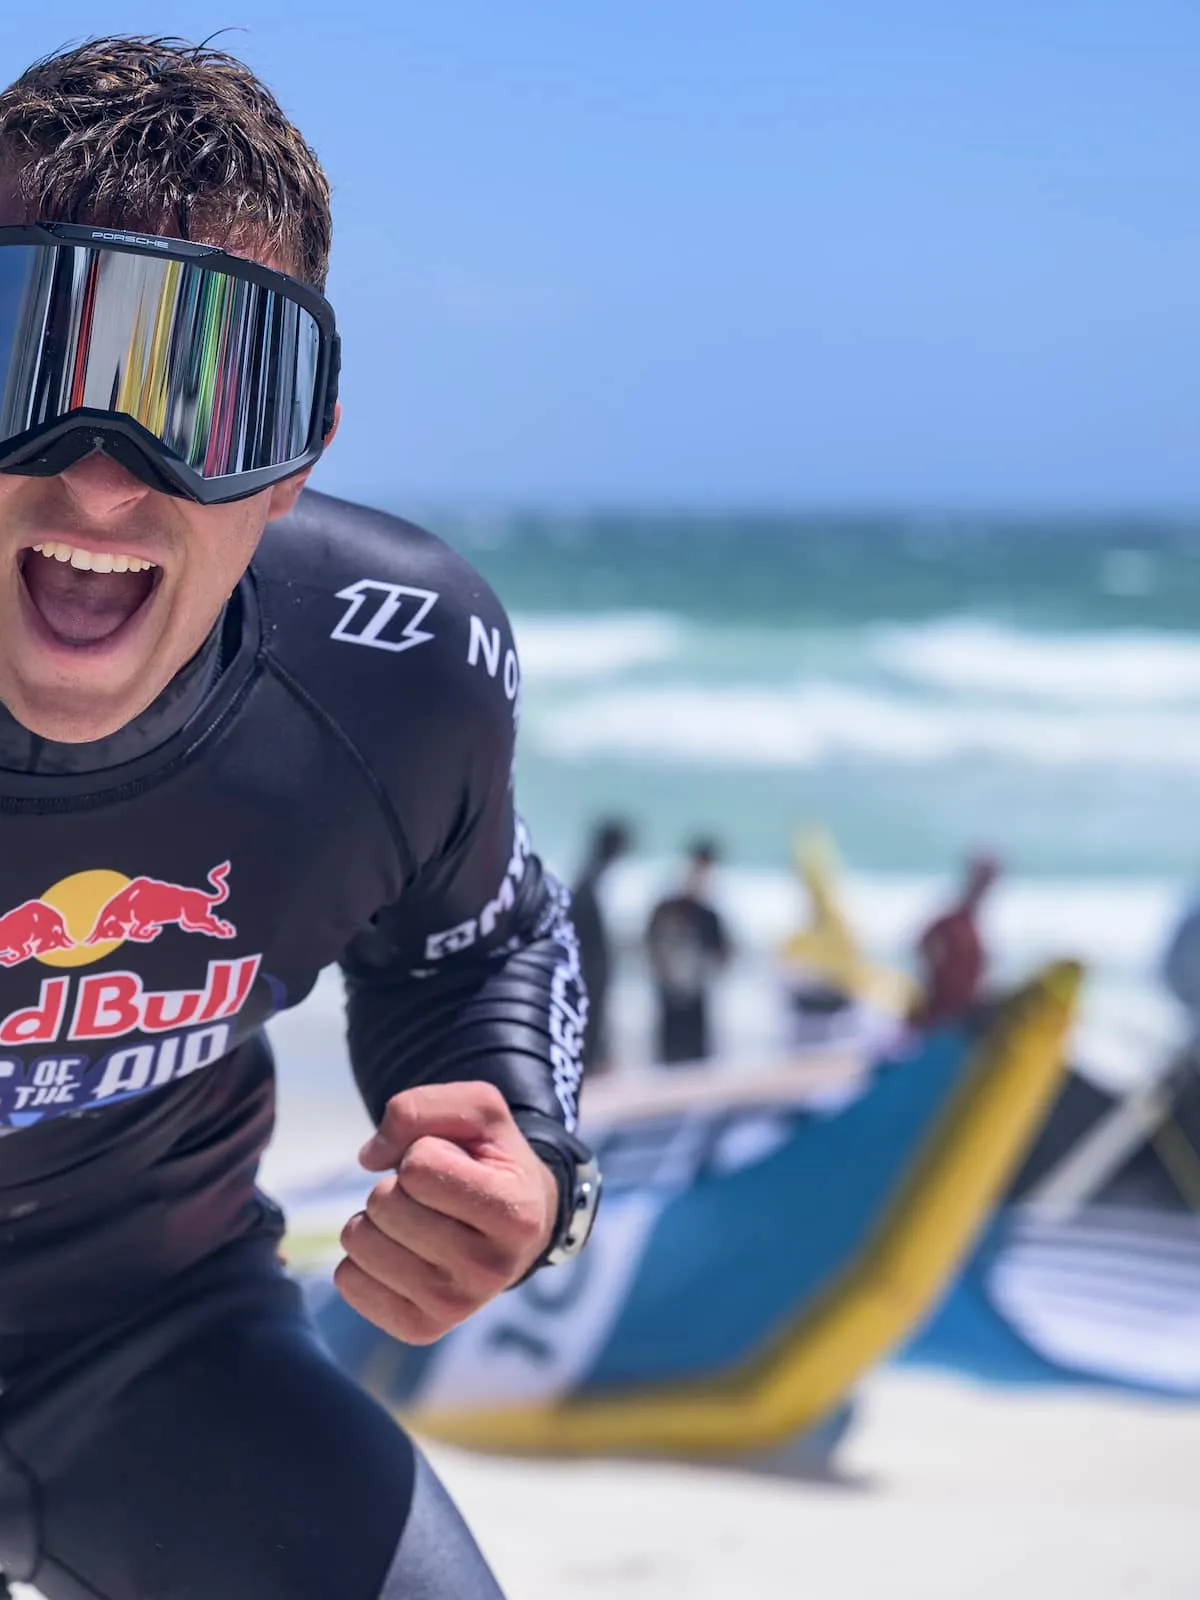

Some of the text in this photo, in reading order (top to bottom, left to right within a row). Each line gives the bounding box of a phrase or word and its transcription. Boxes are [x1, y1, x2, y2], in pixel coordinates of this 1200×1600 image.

[91, 231, 169, 249] PORSCHE
[467, 614, 520, 720] NO
[67, 953, 263, 1041] Bull
[32, 1059, 81, 1087] OF
[14, 1083, 82, 1110] THE
